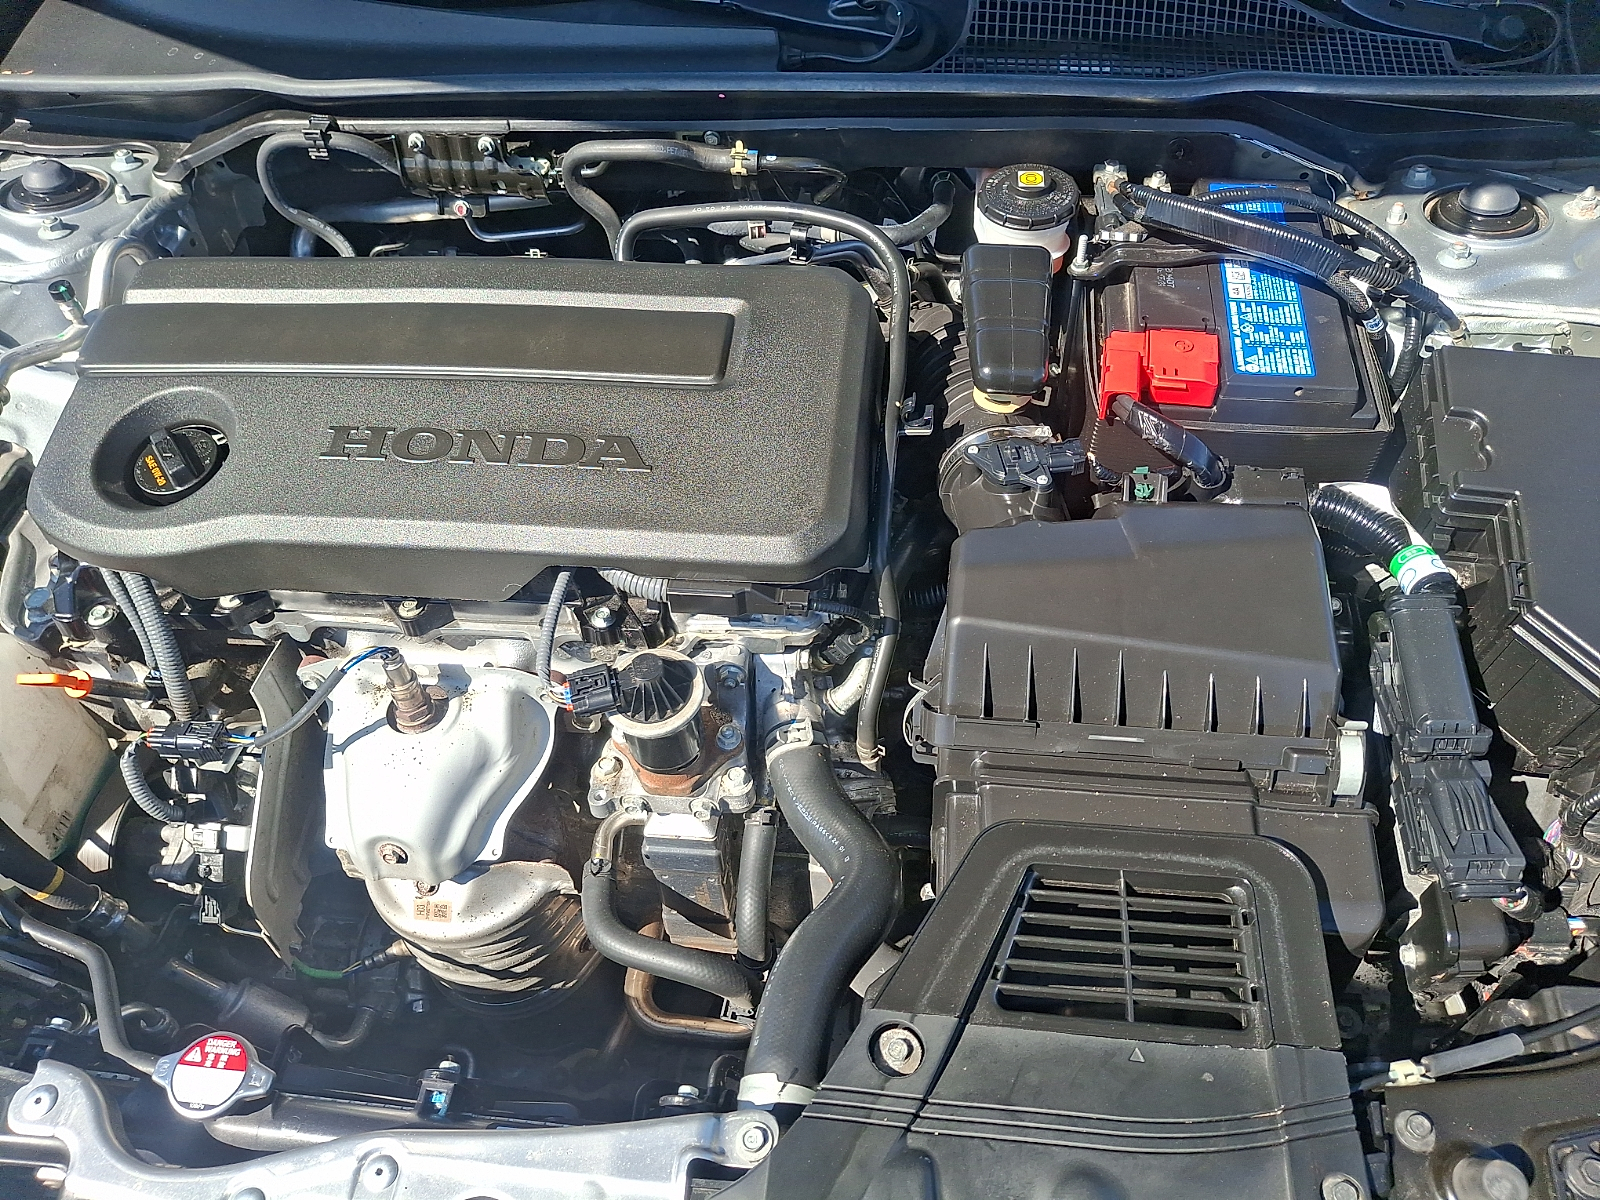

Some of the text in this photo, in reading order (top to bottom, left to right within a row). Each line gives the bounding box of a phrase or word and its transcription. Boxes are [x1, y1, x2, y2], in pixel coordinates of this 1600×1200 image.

[318, 425, 652, 472] HONDA
[145, 455, 167, 487] SAE 0W-20
[204, 1045, 241, 1056] WARNING
[206, 1038, 237, 1049] DANGER
